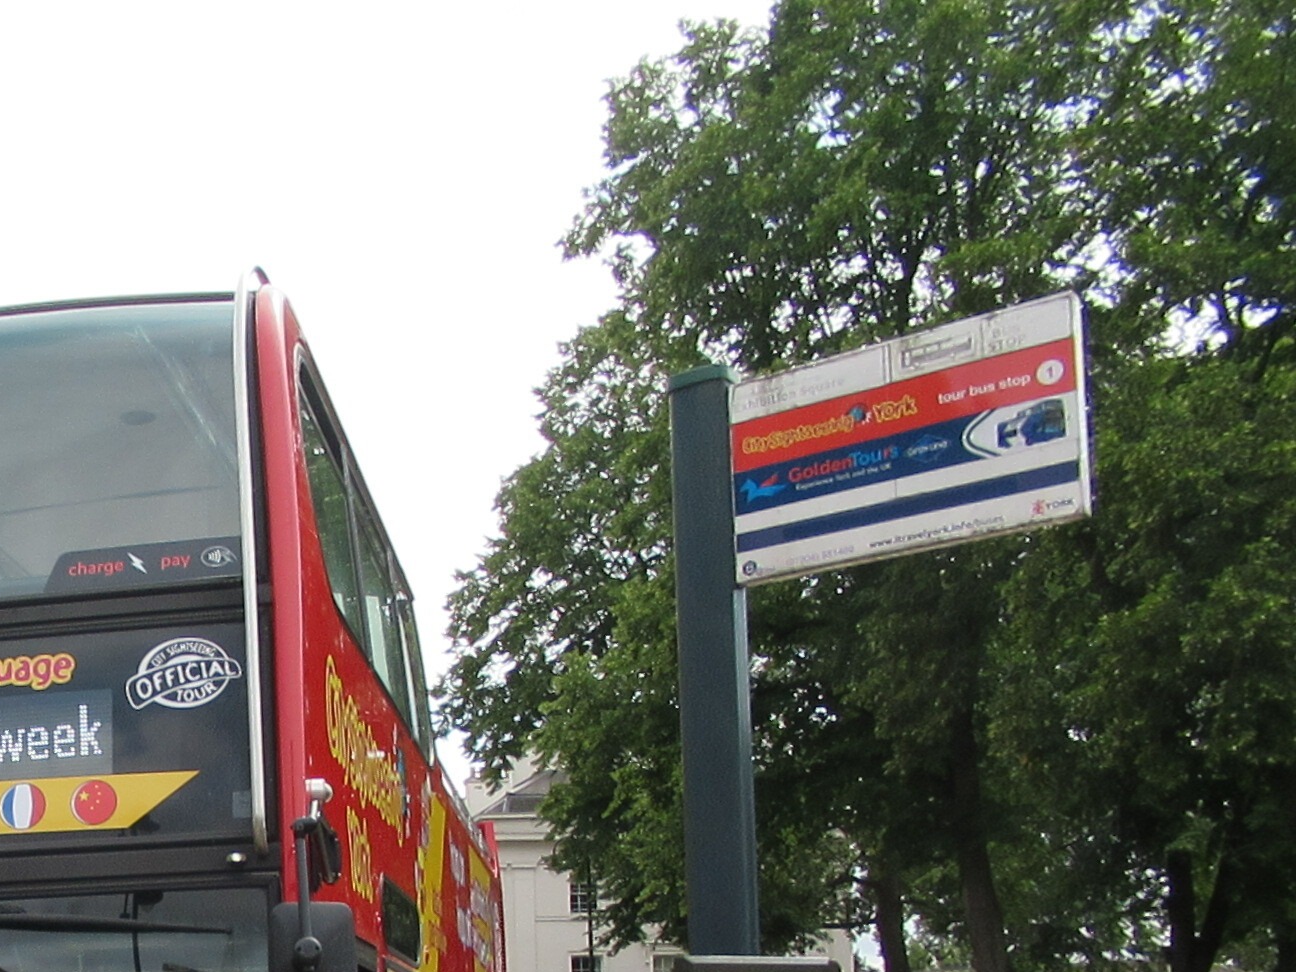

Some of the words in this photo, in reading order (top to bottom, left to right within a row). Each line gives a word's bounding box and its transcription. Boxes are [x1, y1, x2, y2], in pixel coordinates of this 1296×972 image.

[1046, 366, 1055, 379] 1
[937, 389, 966, 405] tour
[969, 383, 995, 397] bus
[998, 373, 1031, 391] stop
[1046, 498, 1075, 509] YORK
[68, 560, 125, 577] charge
[160, 554, 191, 571] pay
[135, 659, 236, 700] OFFICIAL
[176, 681, 218, 703] TOUR
